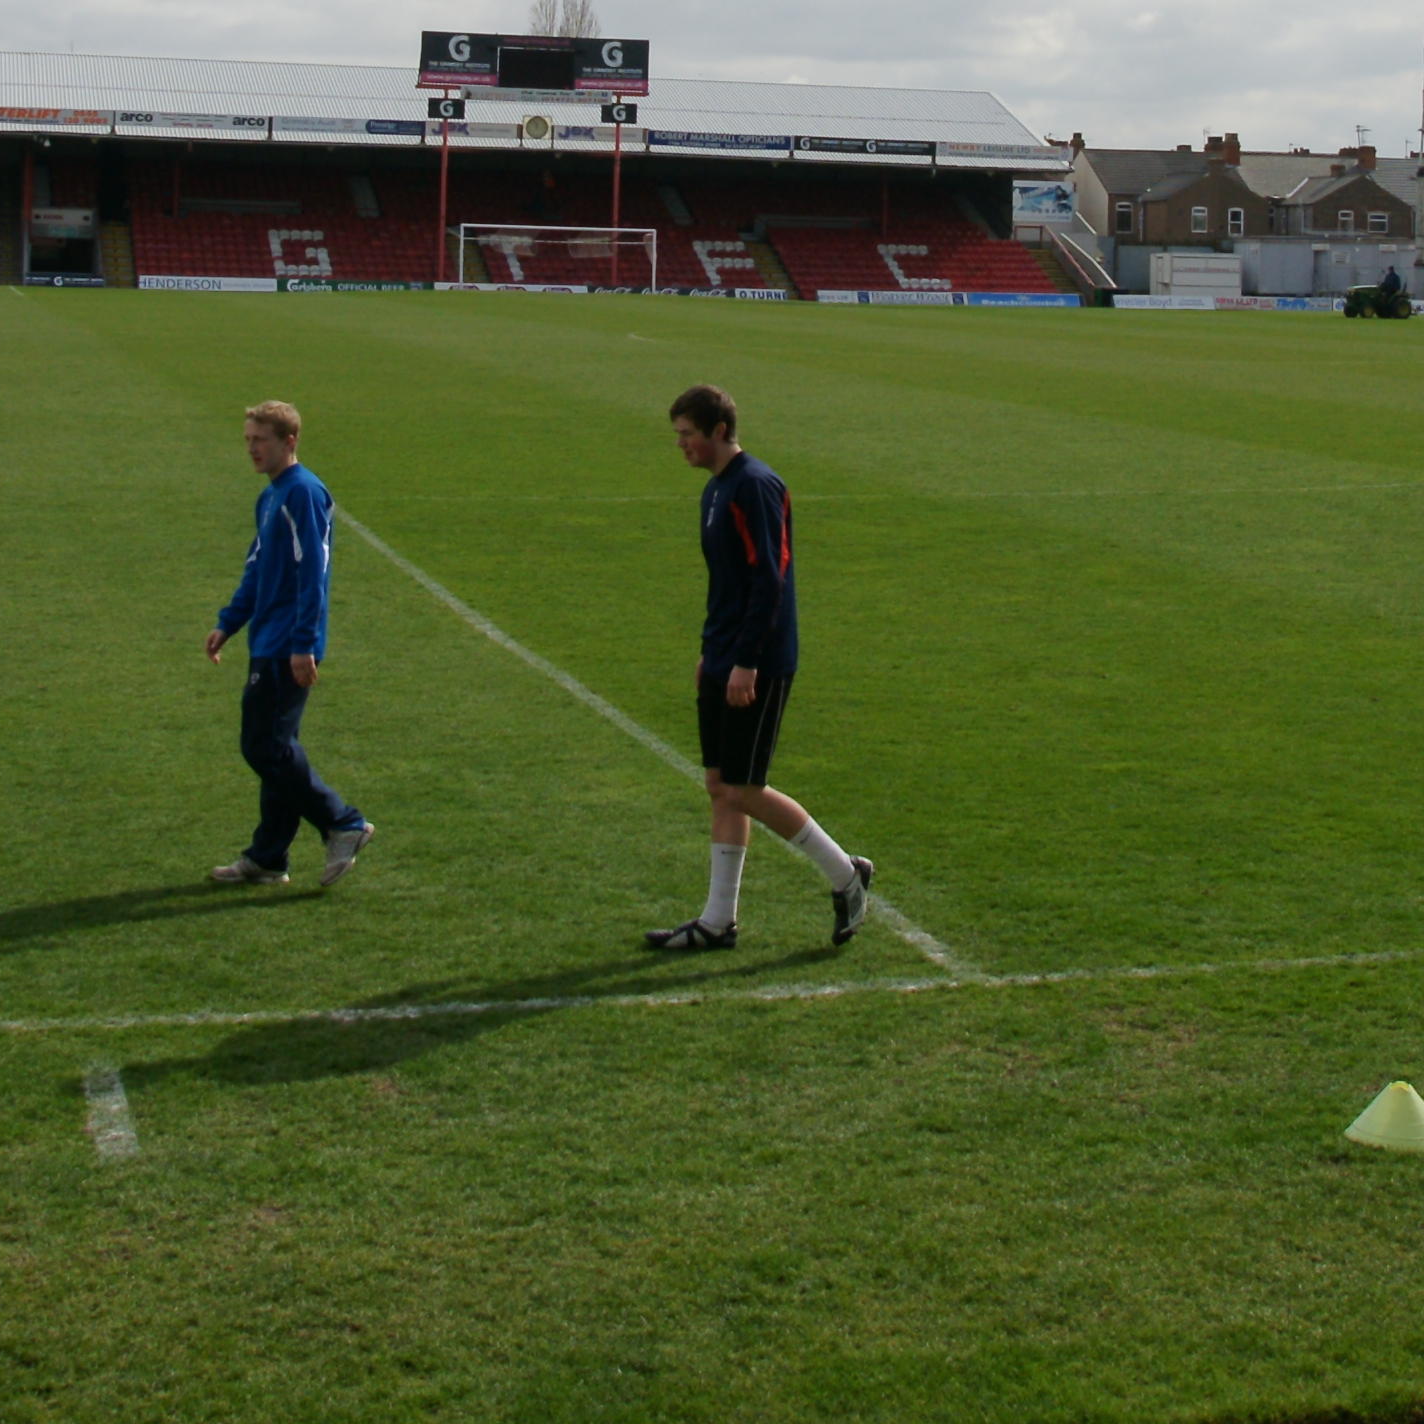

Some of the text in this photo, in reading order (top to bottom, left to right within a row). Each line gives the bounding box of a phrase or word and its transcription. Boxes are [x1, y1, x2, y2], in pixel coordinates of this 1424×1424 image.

[448, 34, 471, 62] G
[601, 41, 624, 67] G
[439, 100, 454, 117] G
[612, 104, 626, 121] G
[120, 112, 153, 122] arco
[232, 116, 265, 126] arco
[689, 133, 736, 143] MARSHALL
[738, 135, 786, 145] OPTICIANS
[139, 277, 222, 290] HENDERSON
[337, 282, 377, 291] OFFICIAL
